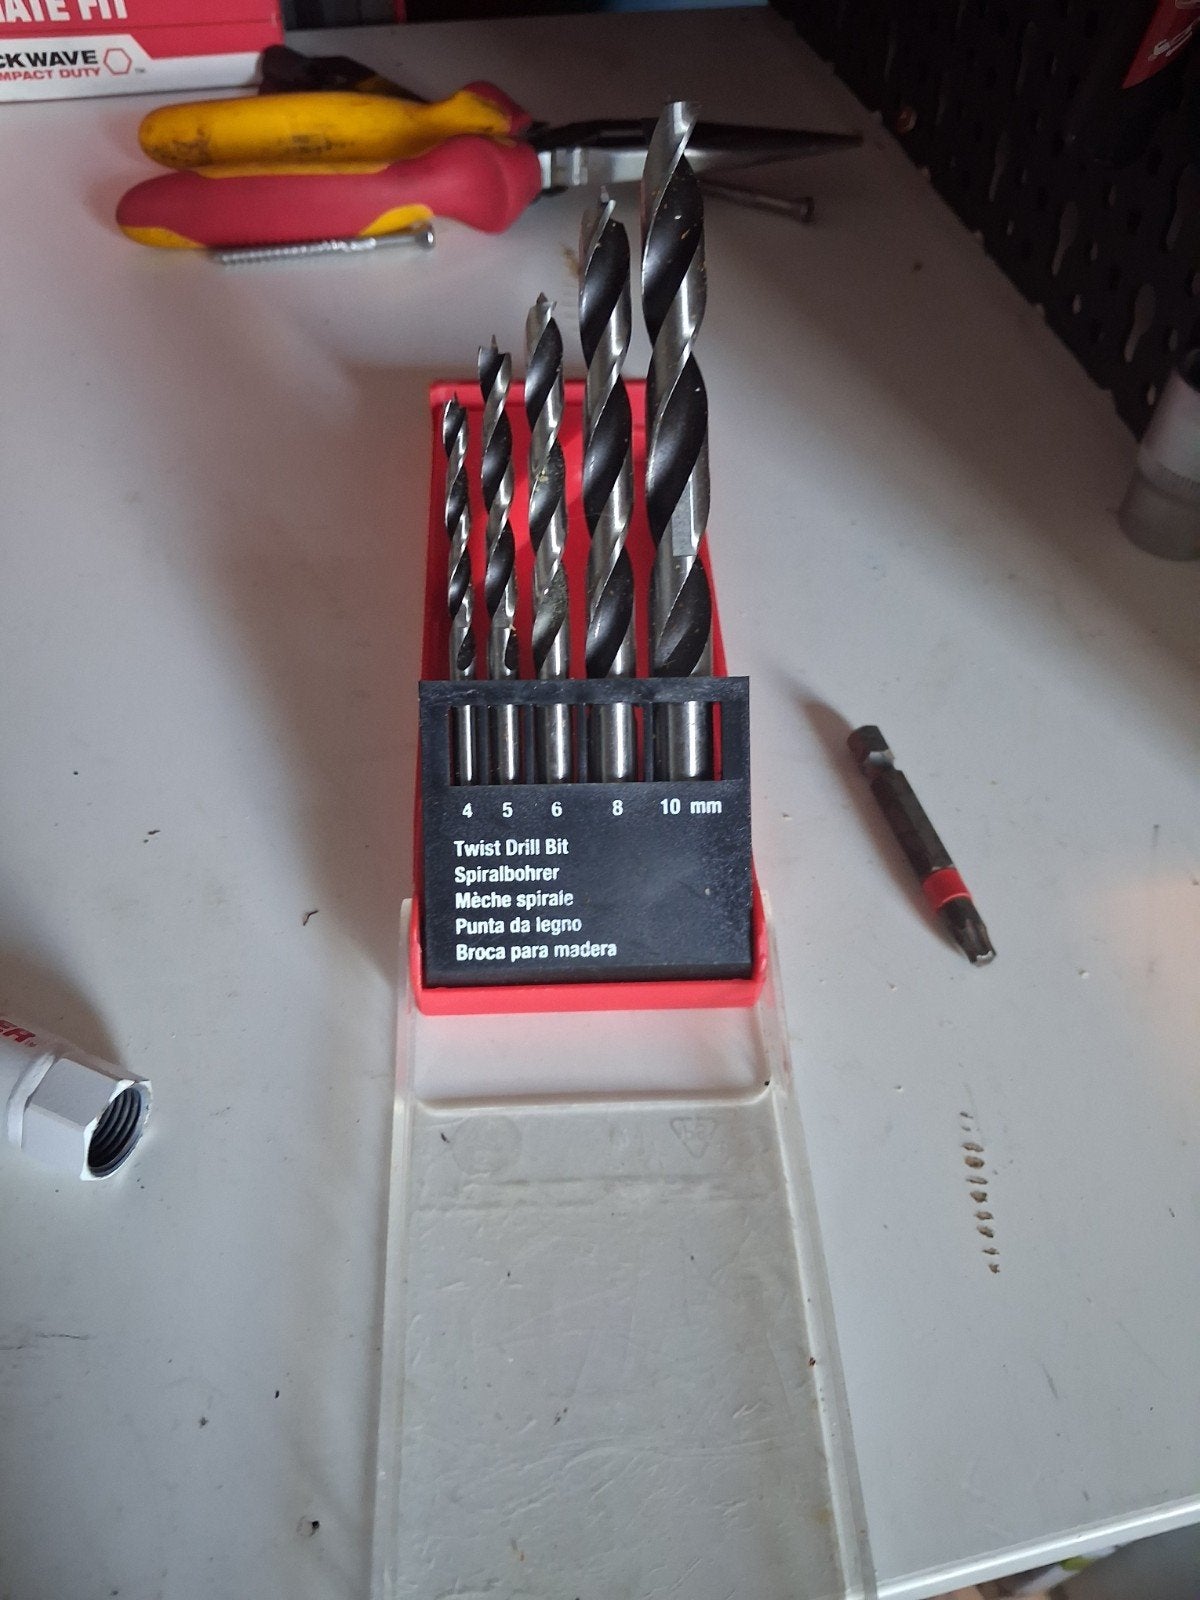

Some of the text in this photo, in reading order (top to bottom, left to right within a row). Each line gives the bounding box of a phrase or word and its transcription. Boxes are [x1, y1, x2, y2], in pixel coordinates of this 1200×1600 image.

[0, 0, 71, 22] ATE
[60, 67, 101, 78] DUTY
[462, 798, 723, 819] 4 5 6 8 10 mm
[454, 838, 570, 858] Twist Drill Bit
[454, 864, 561, 886] Spiralbohrer
[455, 890, 574, 911] Mèche spirale
[455, 916, 583, 936] Punta da legno
[455, 940, 618, 963] Broca para madera
